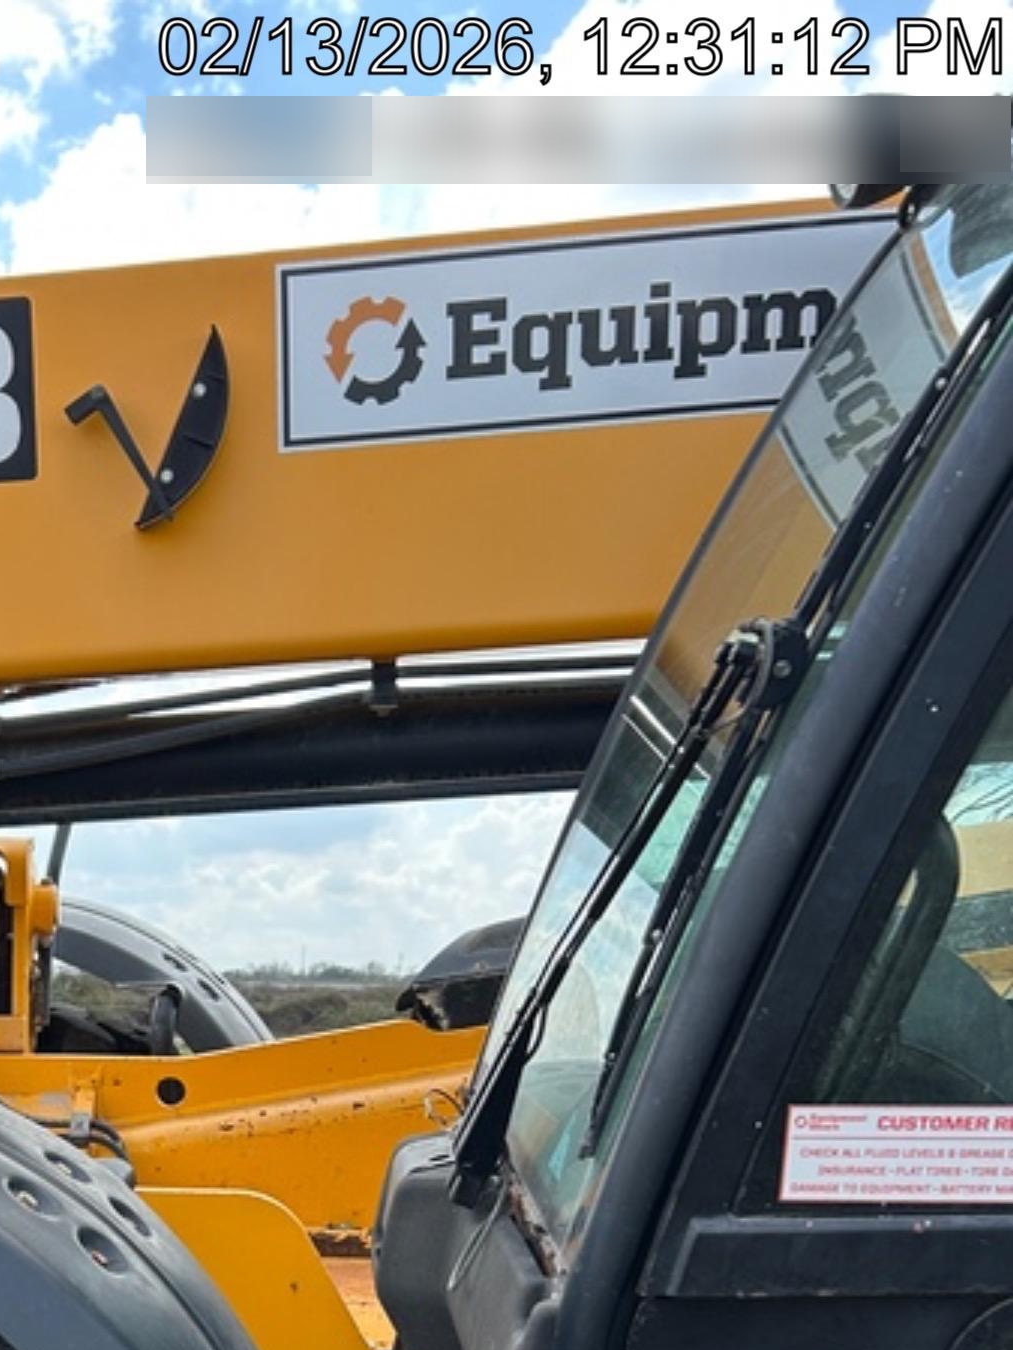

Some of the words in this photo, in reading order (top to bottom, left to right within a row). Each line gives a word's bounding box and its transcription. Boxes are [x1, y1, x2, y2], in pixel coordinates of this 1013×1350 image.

[446, 282, 836, 391] Equipm
[877, 1116, 989, 1131] CUSTOMER
[800, 1147, 838, 1158] CHECK
[842, 1147, 861, 1158] ALL
[864, 1147, 900, 1158] FLUID
[902, 1148, 945, 1158] LEVELS
[818, 1165, 885, 1176] INSURANCE
[896, 1166, 924, 1176] FLAT
[843, 1183, 858, 1193] TO
[861, 1183, 930, 1194] EQUIPMENT
[940, 1184, 993, 1194] BATTERY
